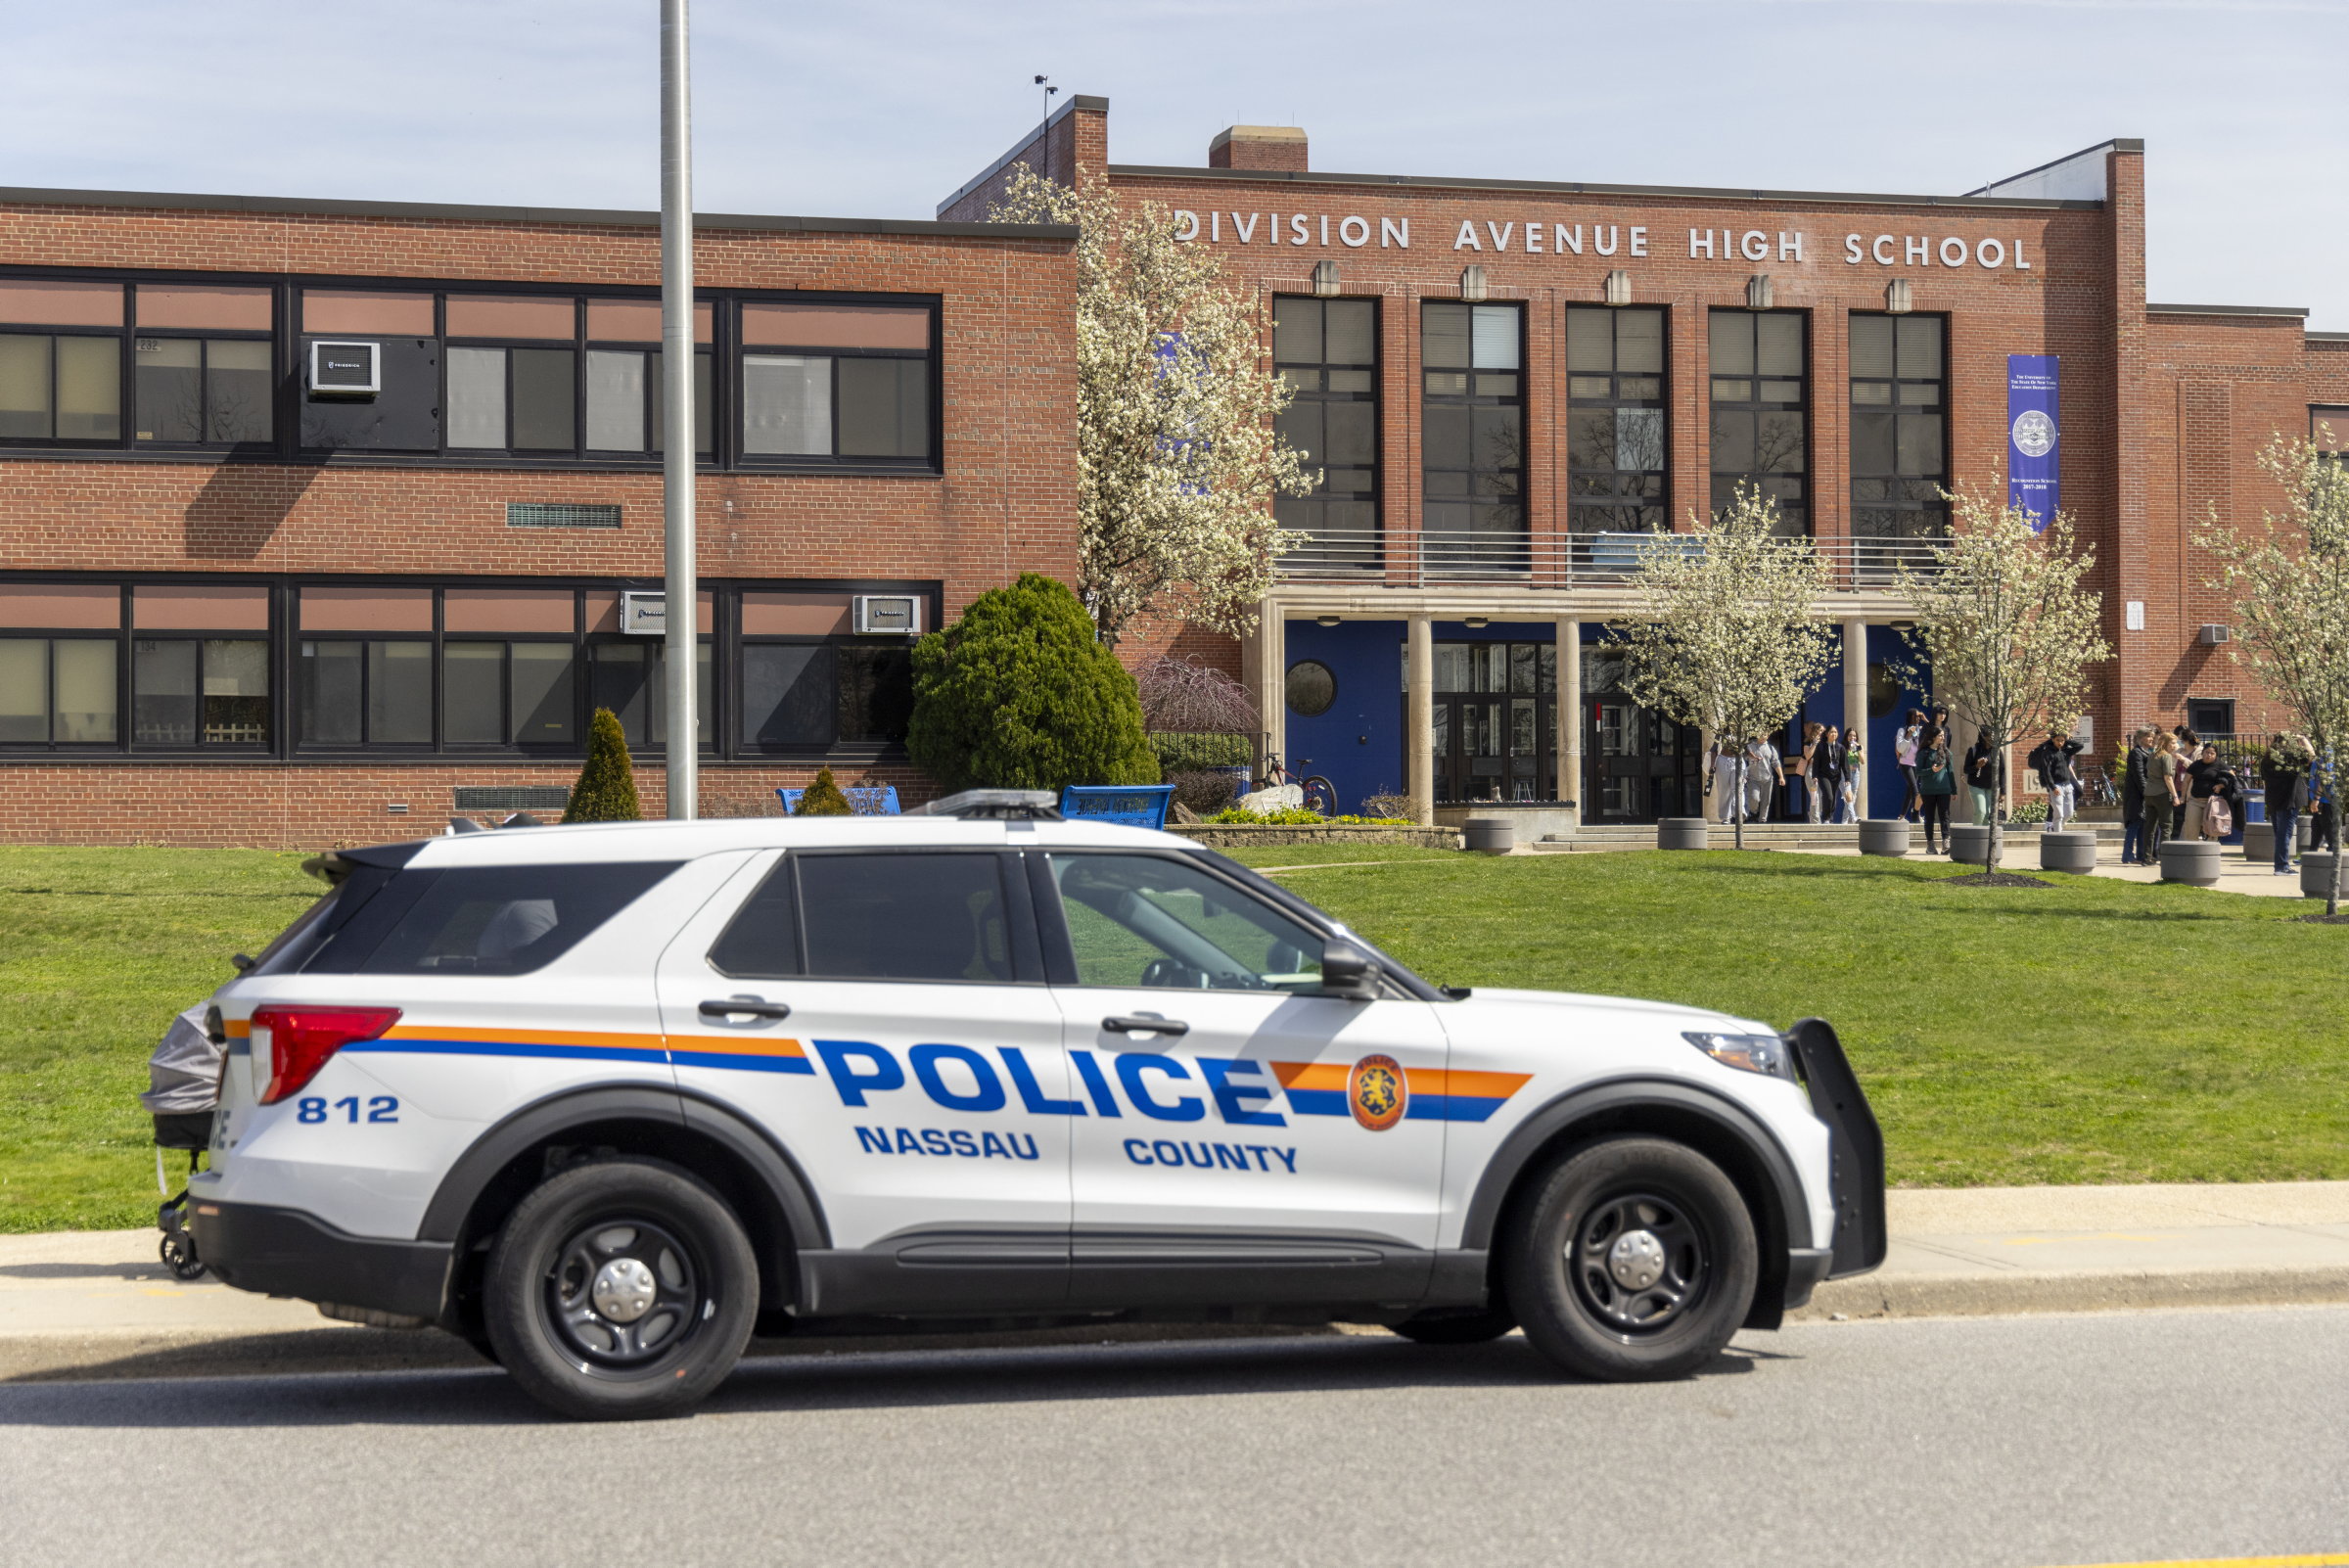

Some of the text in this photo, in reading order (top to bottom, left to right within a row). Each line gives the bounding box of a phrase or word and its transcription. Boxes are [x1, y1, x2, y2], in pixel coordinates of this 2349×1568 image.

[1174, 209, 2031, 270] DIVISION AVENUE HIGH SCHOOL
[811, 1038, 1288, 1128] POLICE
[1358, 1054, 1399, 1072] POLICE
[297, 1095, 399, 1125] 812
[853, 1126, 1299, 1175] NASSAU COUNTY
